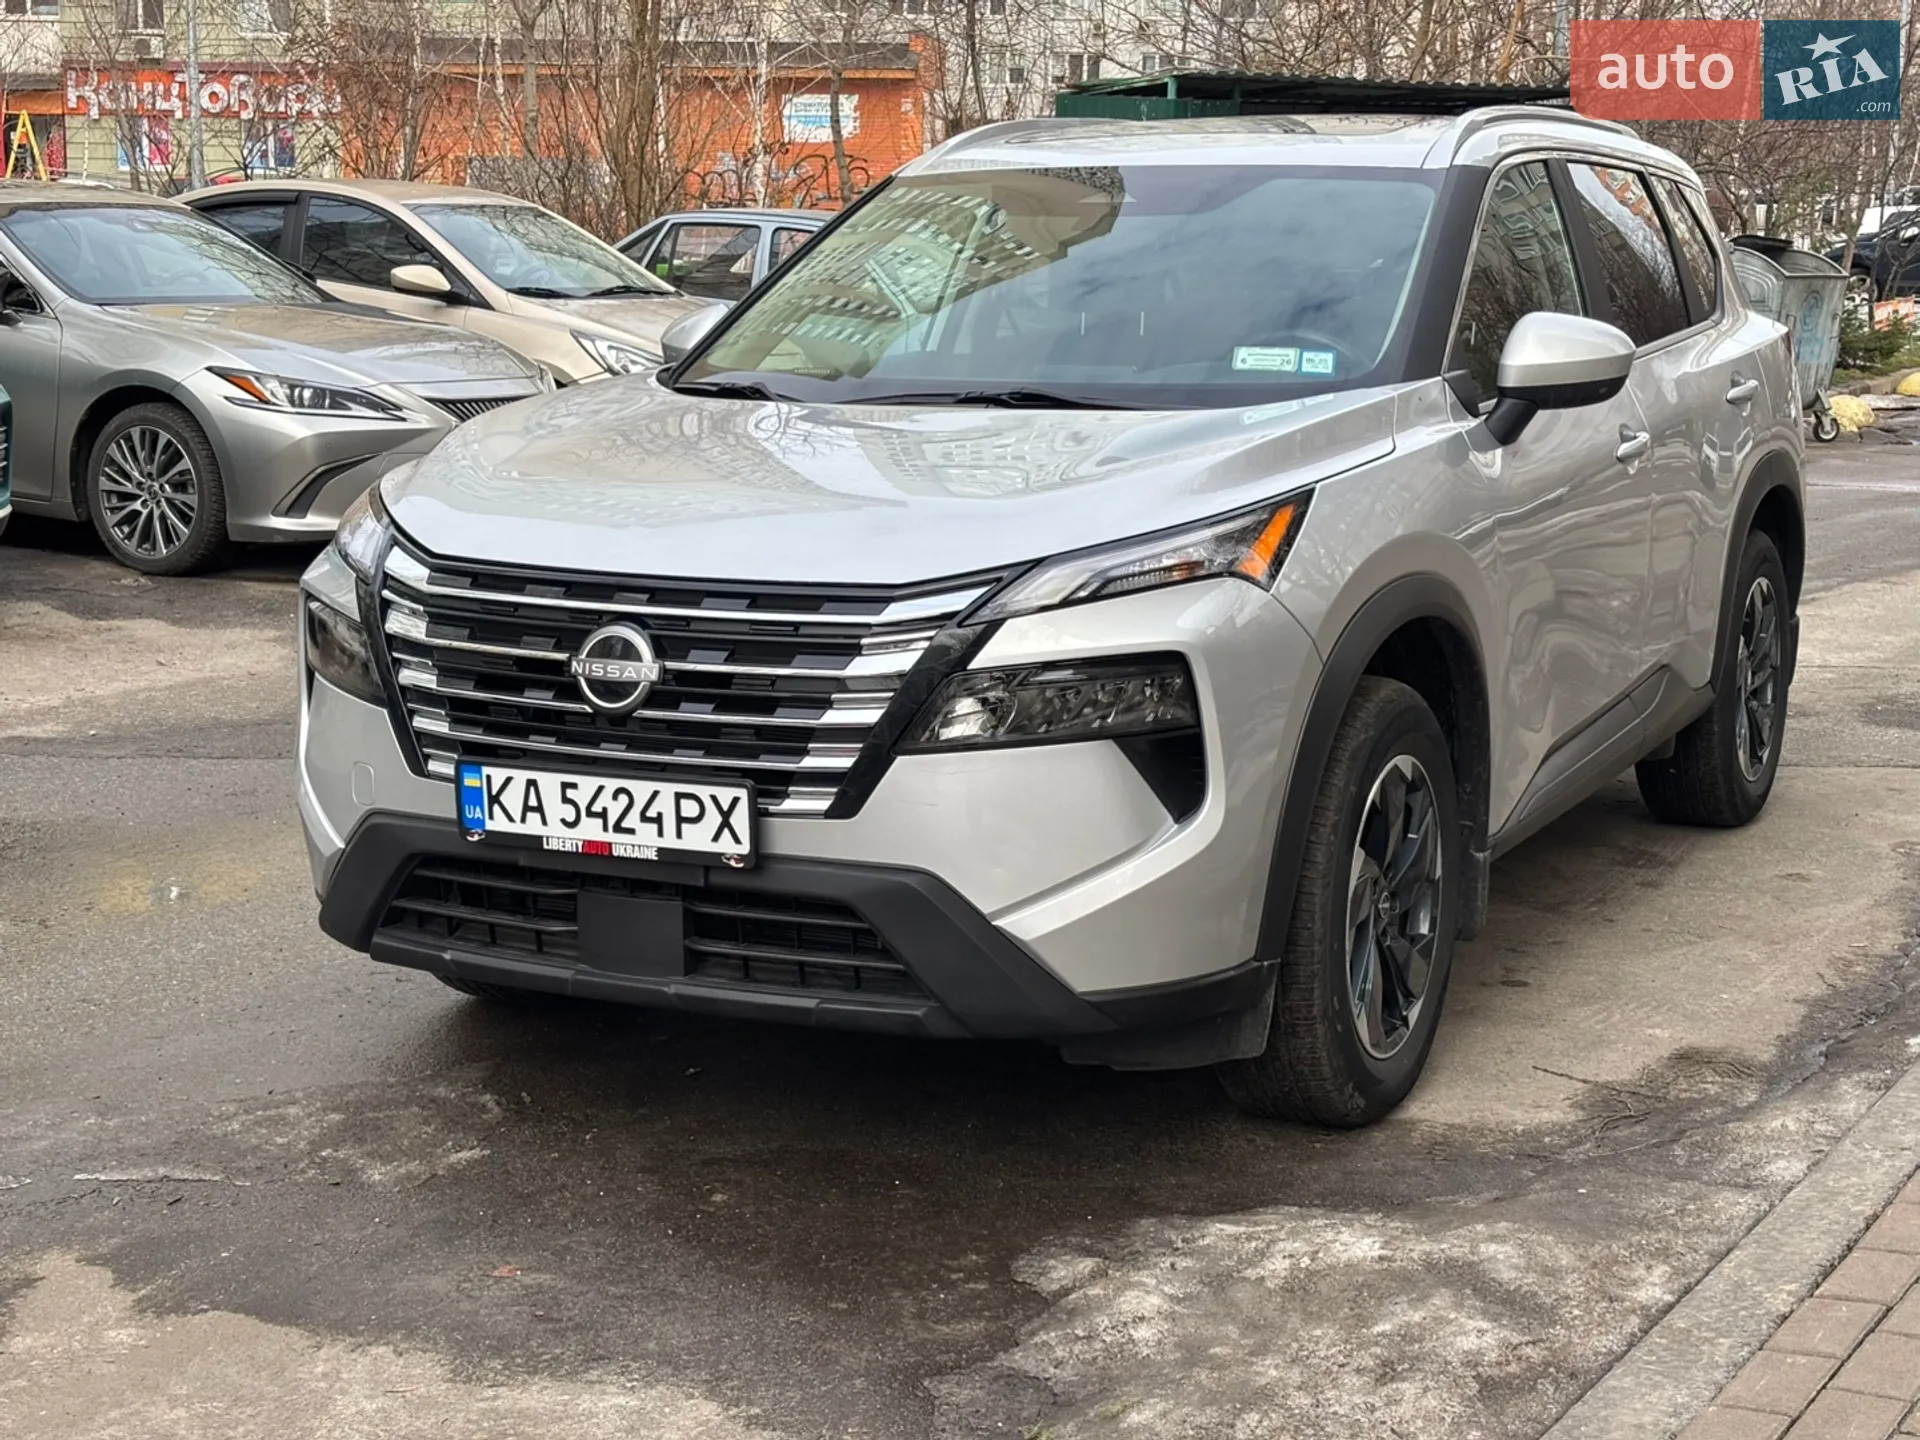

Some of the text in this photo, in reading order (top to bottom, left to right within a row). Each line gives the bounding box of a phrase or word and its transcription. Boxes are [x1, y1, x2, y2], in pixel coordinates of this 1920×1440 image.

[572, 660, 656, 681] NISSAN
[485, 774, 548, 829] KA
[465, 808, 483, 821] UA
[612, 841, 659, 861] UKRAINE
